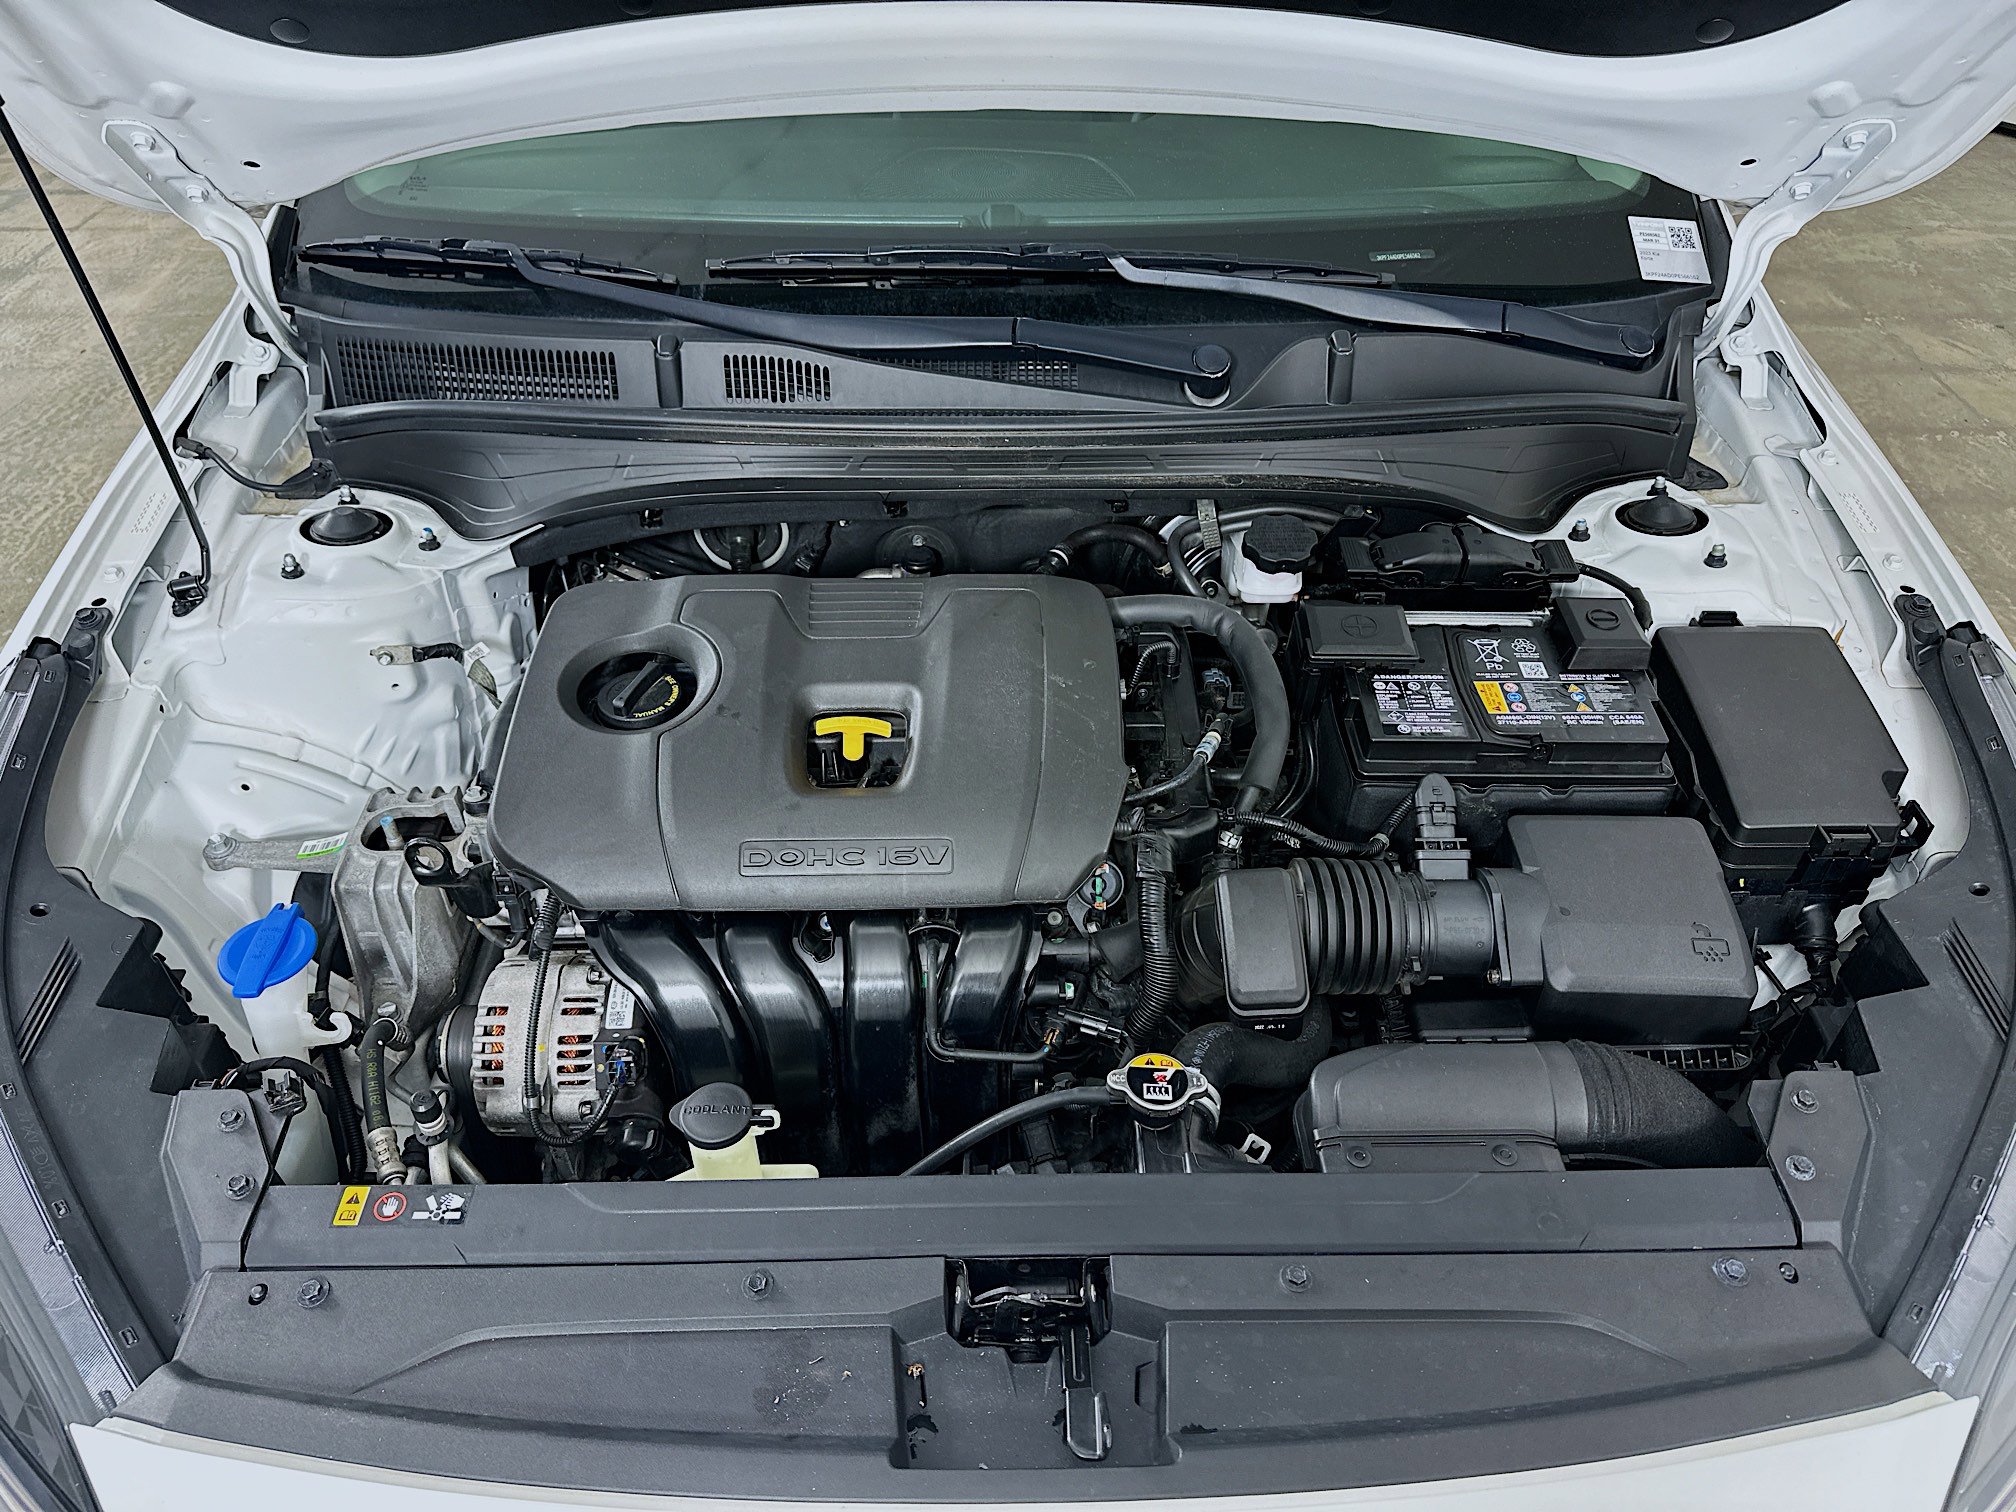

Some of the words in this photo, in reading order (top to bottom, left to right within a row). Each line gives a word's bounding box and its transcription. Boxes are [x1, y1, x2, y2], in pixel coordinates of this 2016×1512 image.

[1485, 662, 1504, 671] Pb
[633, 705, 665, 718] MANUAL
[742, 847, 865, 868] DOHC
[877, 845, 950, 866] 16V
[684, 1104, 750, 1116] COOLANT
